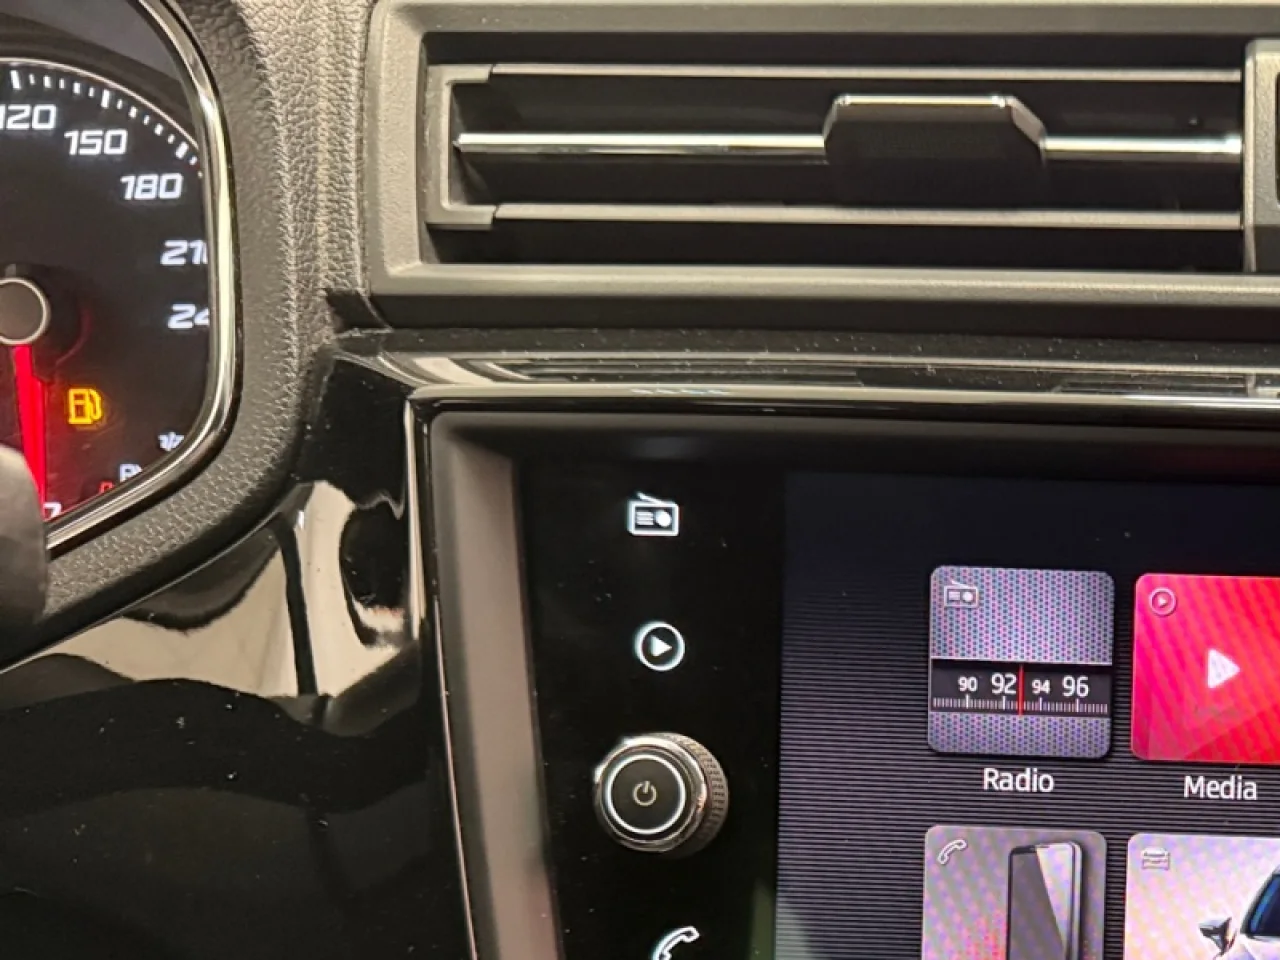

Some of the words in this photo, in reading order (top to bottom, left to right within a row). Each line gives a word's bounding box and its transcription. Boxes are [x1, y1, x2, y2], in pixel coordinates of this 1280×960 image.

[64, 129, 128, 156] 150
[120, 172, 183, 200] 180
[160, 239, 208, 265] 21
[958, 676, 978, 692] 90
[991, 673, 1017, 694] 92
[1031, 679, 1051, 694] 94
[1062, 675, 1089, 698] 96
[983, 767, 1055, 793] Radio
[1183, 775, 1258, 800] Media
